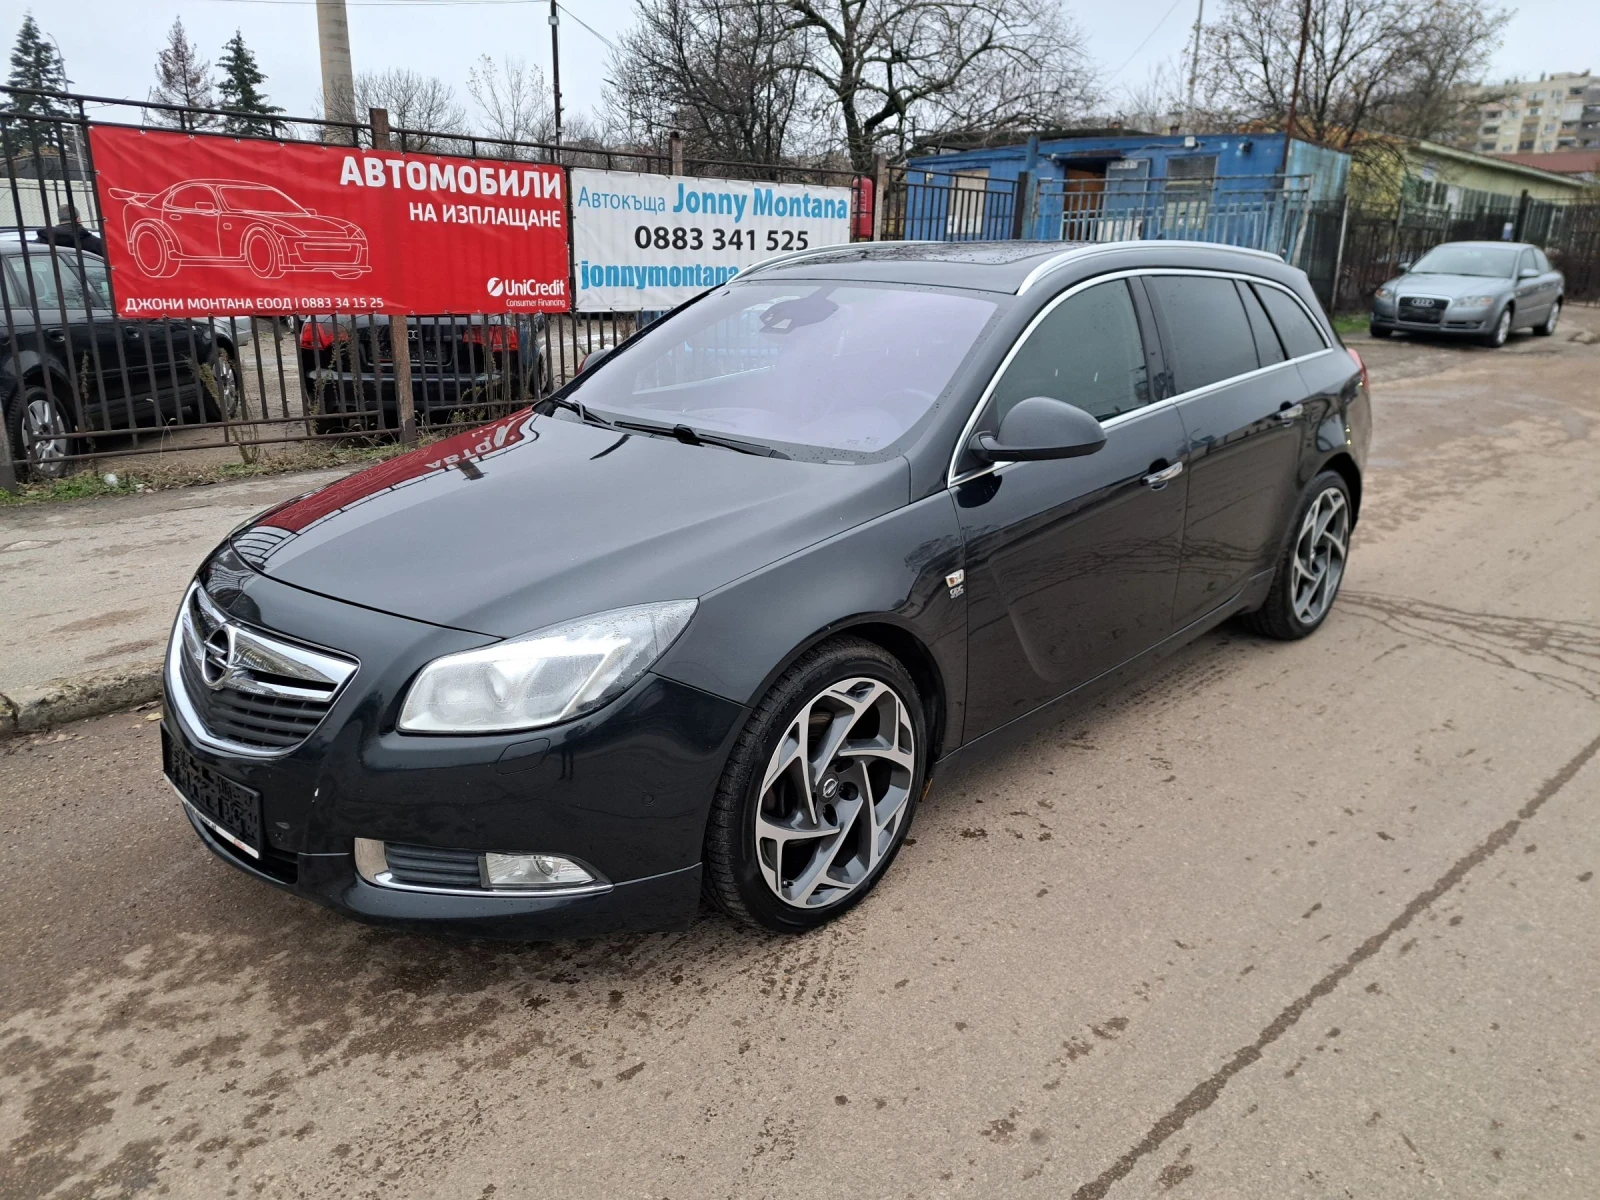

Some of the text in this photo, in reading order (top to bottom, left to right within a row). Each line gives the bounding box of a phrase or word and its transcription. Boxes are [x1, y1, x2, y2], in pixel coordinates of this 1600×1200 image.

[340, 155, 562, 200] АВТОМОБИЛИ
[577, 182, 848, 224] Автокъща Jonny Montana
[409, 202, 562, 231] НА ИЗПЛАЩАНЕ
[635, 225, 809, 251] 0883 341 525
[504, 278, 565, 296] UniCredit
[125, 297, 184, 312] ДЖОНИ
[187, 297, 254, 310] МОНТАНА
[256, 297, 293, 311] ЕООД
[301, 297, 332, 309] 0883
[334, 297, 350, 308] 34
[352, 297, 367, 309] 15
[369, 297, 384, 309] 25
[505, 298, 566, 308] Consumer Financing
